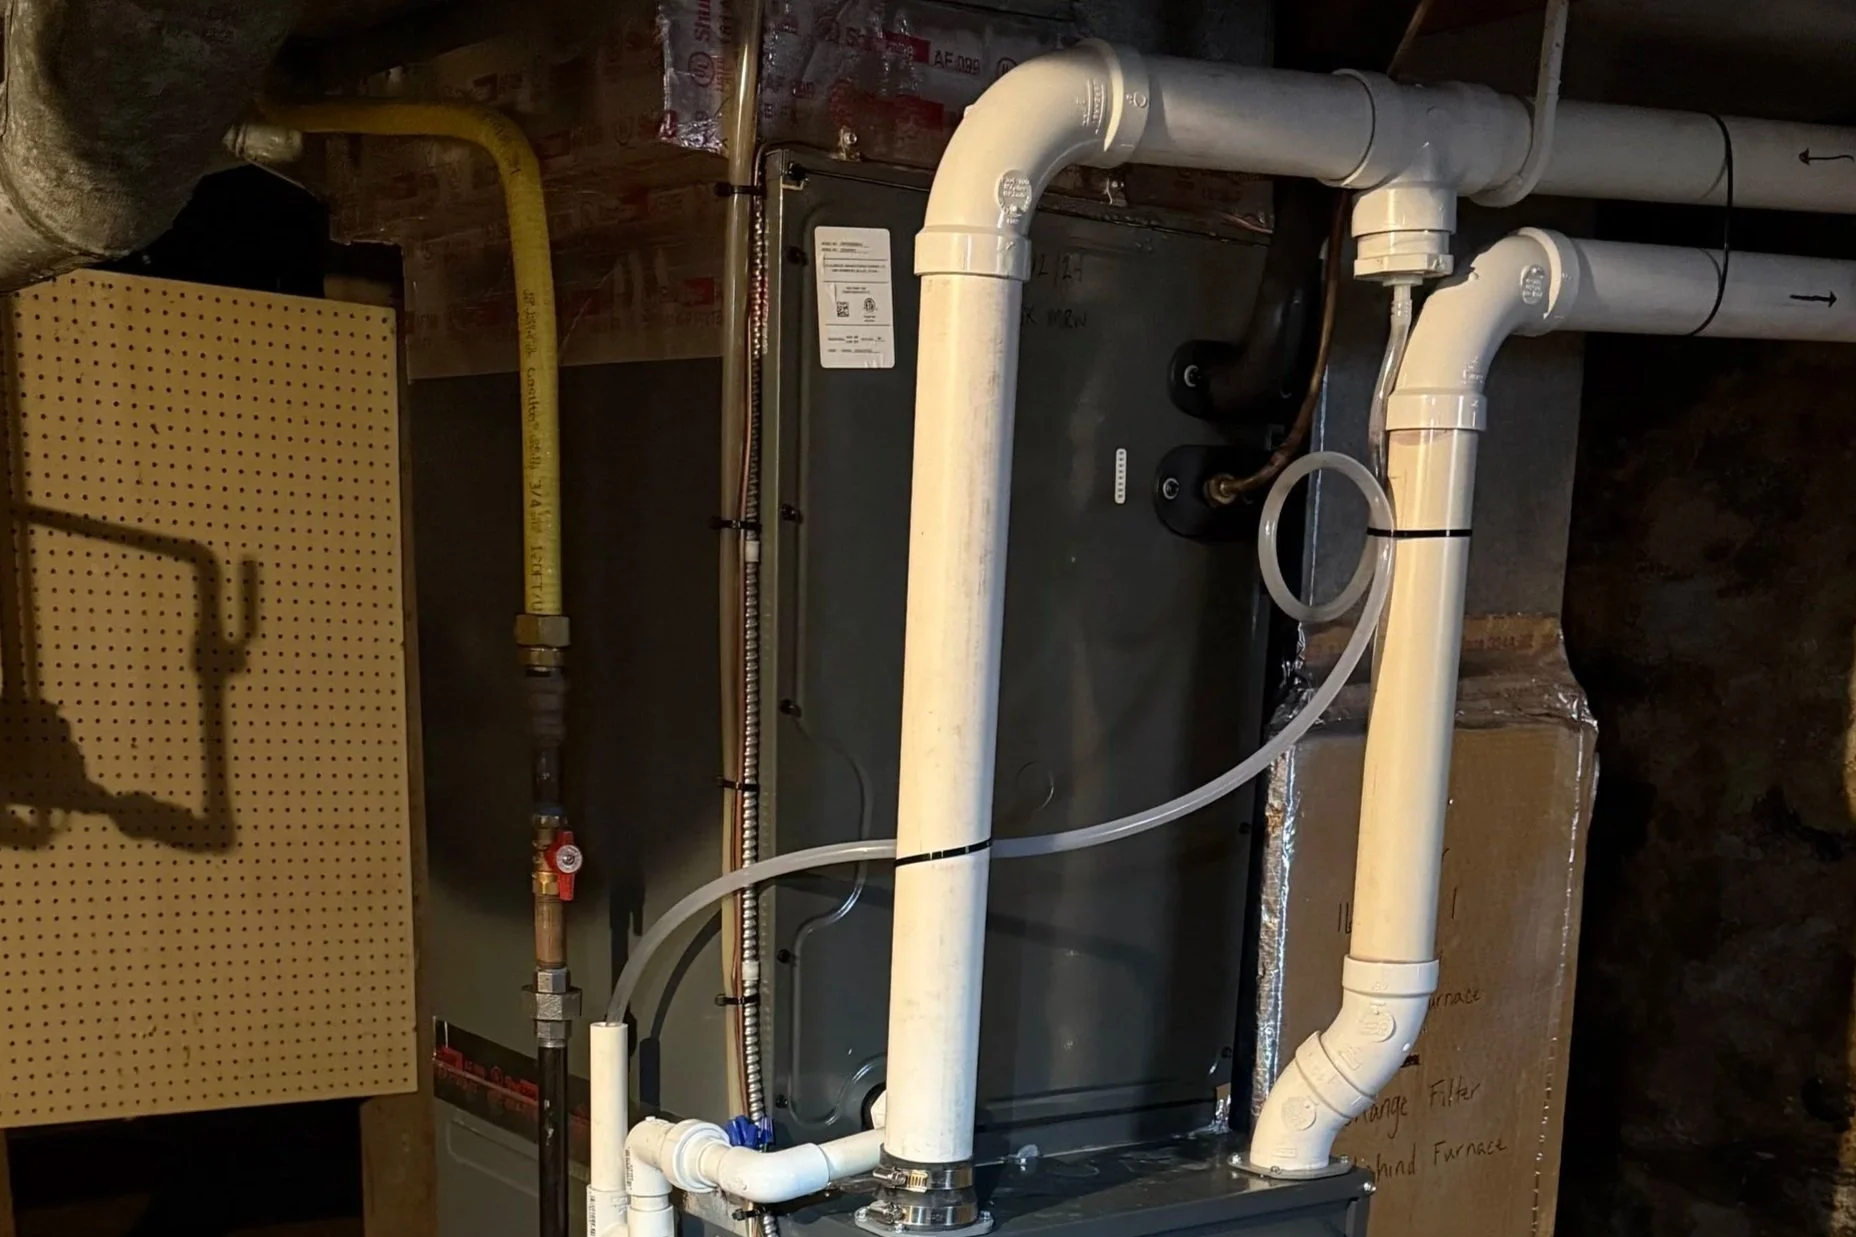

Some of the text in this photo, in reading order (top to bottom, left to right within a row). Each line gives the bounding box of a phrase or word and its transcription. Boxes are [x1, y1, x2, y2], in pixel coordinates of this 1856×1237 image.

[1429, 988, 1482, 1010] urnace
[1429, 1078, 1483, 1110] Filter
[1433, 1141, 1508, 1166] Furnace
